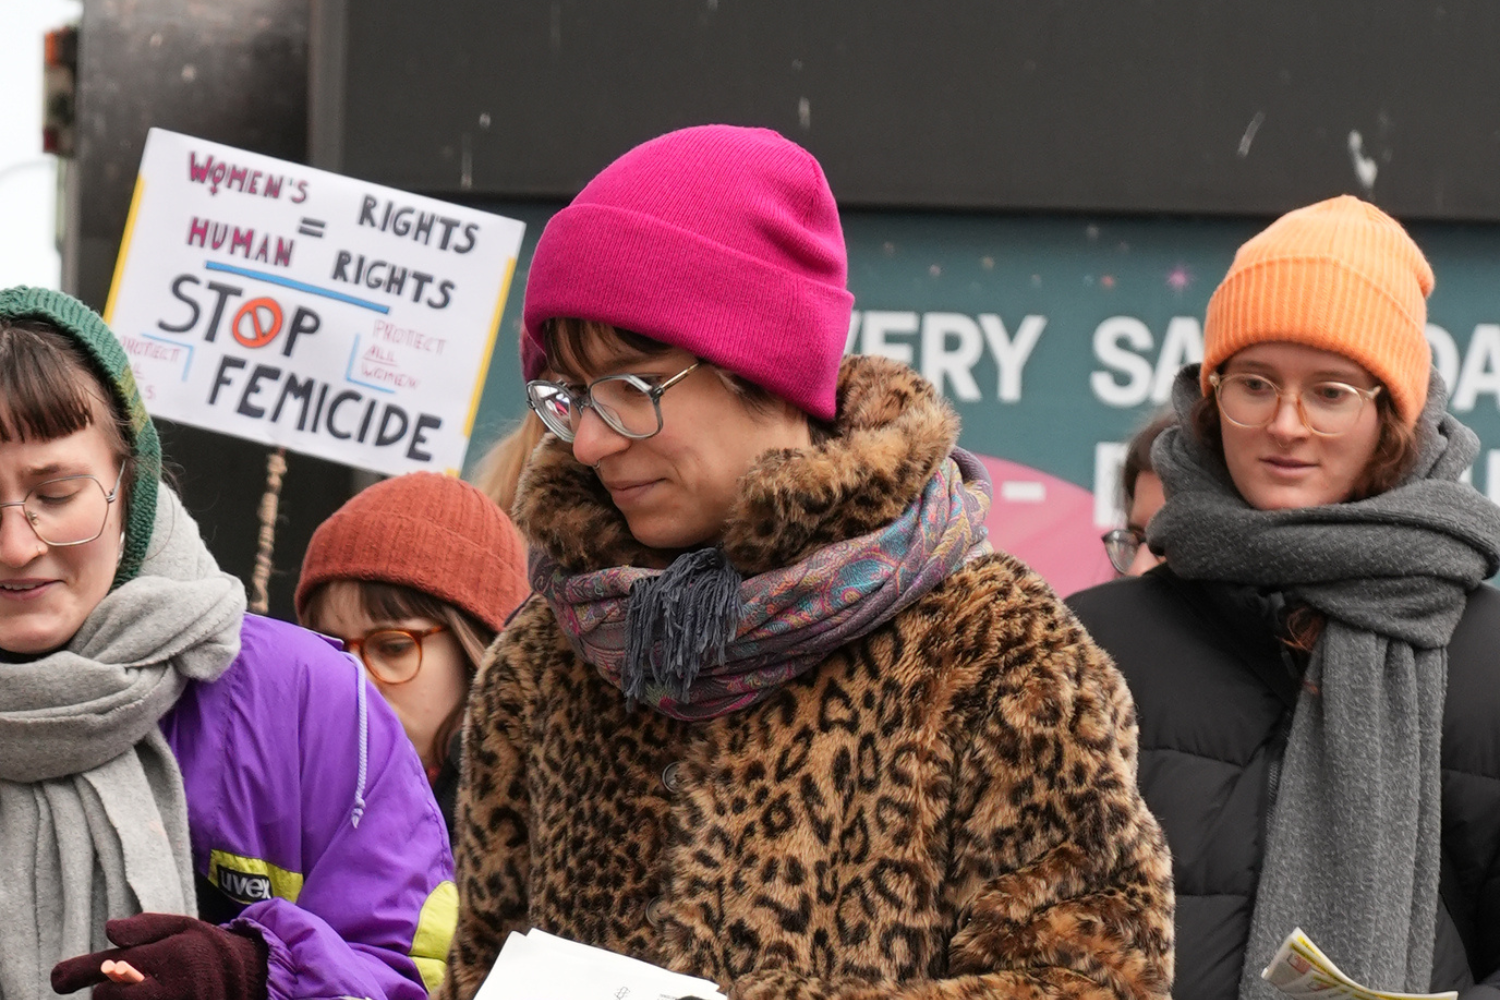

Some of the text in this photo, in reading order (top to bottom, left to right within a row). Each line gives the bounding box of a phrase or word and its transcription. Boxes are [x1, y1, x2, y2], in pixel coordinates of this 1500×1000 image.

[187, 150, 309, 204] WOMEN'S
[357, 194, 480, 254] RIGHTS
[186, 216, 456, 309] HUMAN RIGHTS
[157, 272, 321, 357] STOP
[372, 318, 447, 356] PROTECT
[207, 354, 443, 463] FEMICIDE
[219, 869, 272, 900] uvex
